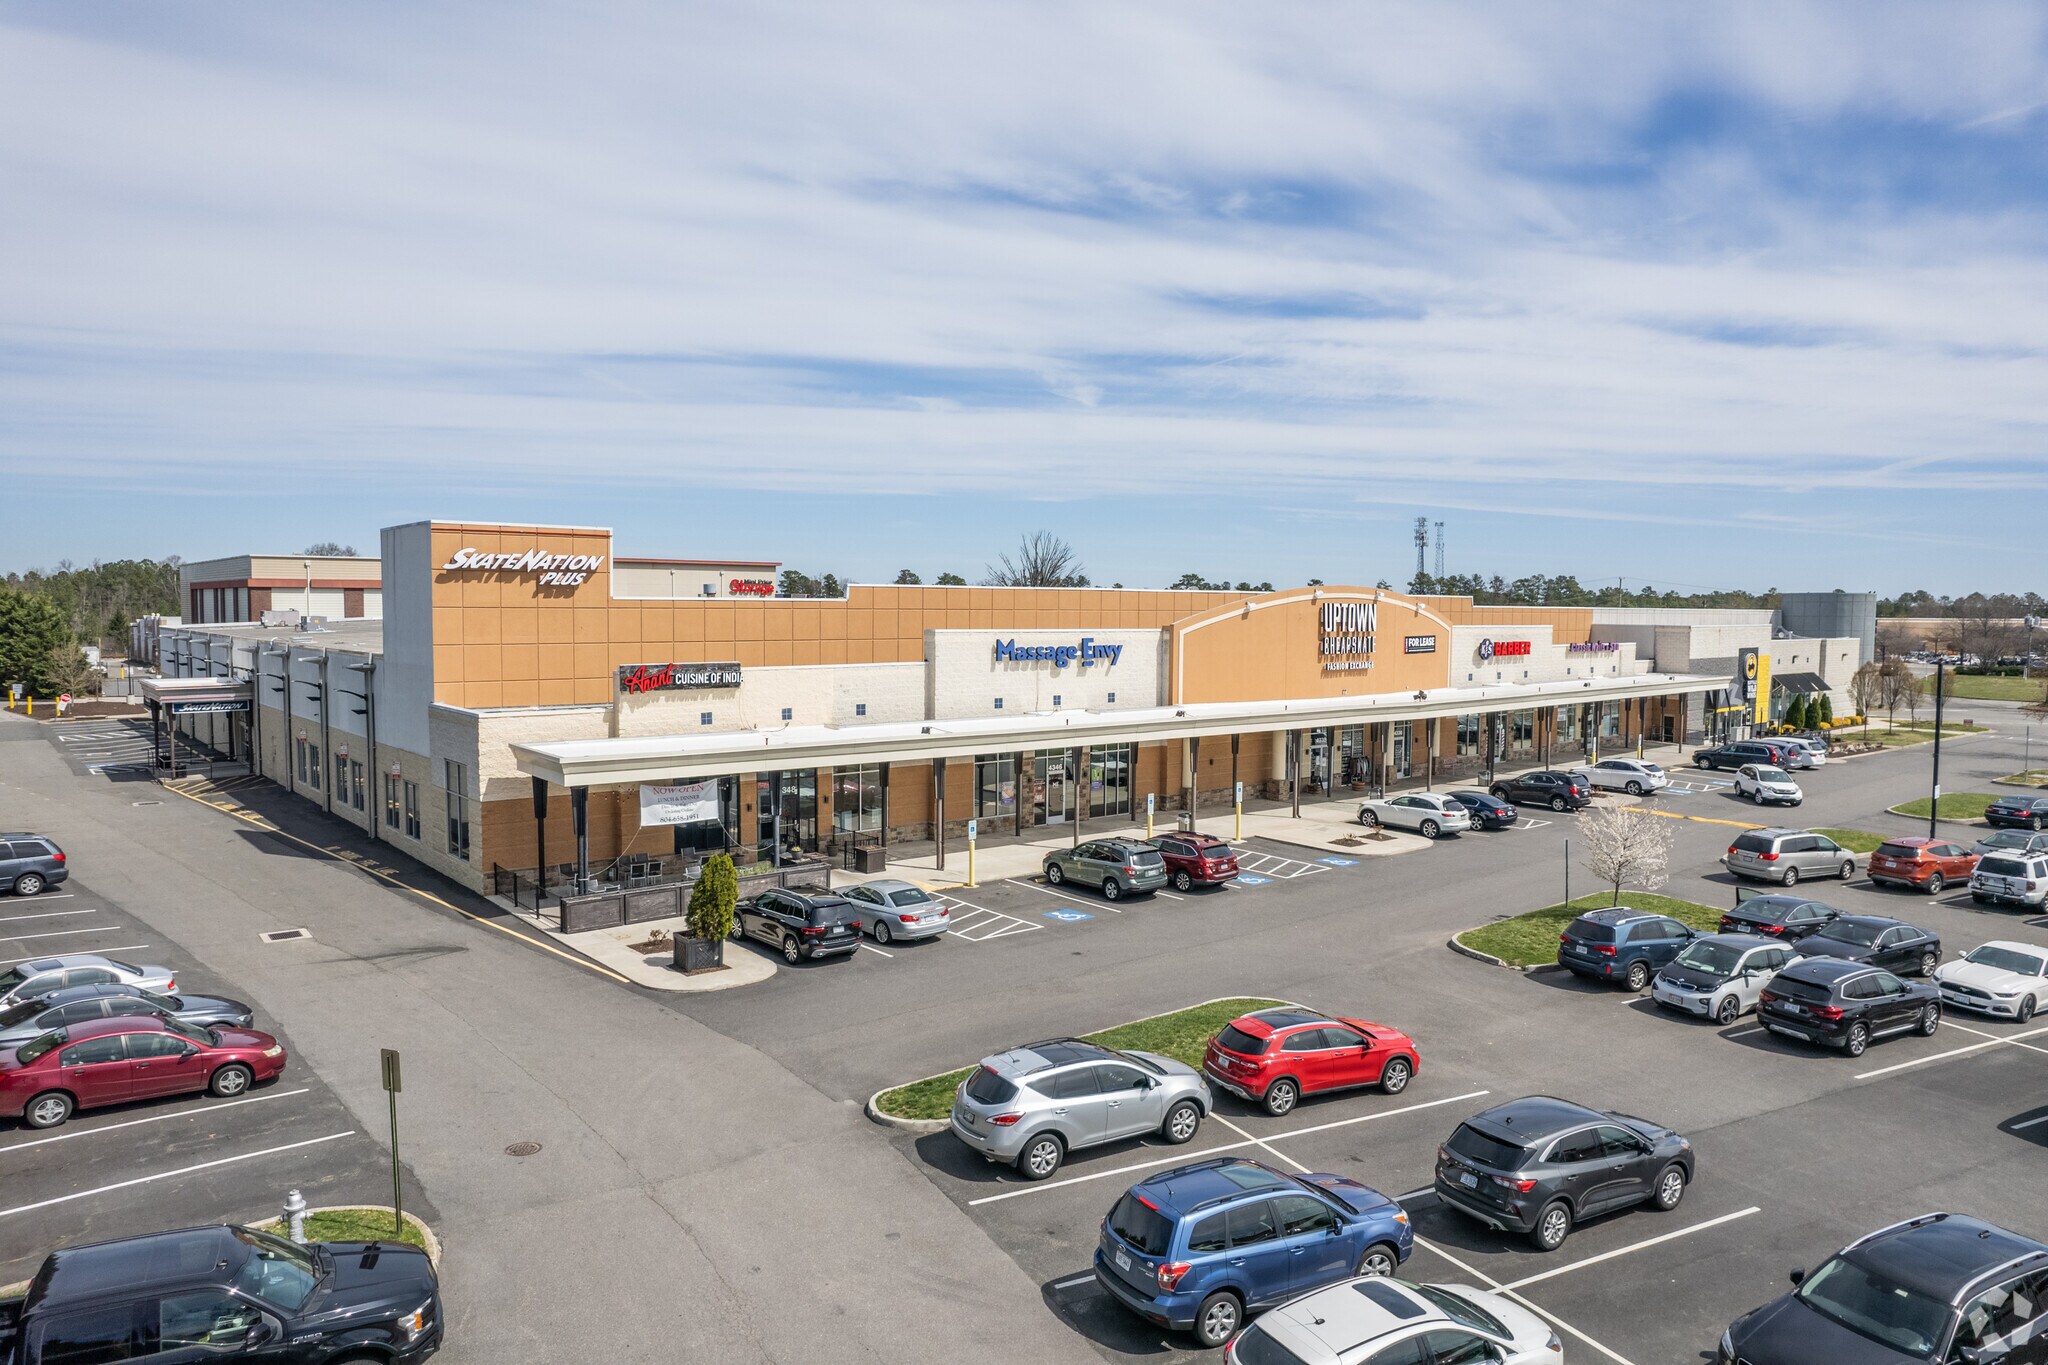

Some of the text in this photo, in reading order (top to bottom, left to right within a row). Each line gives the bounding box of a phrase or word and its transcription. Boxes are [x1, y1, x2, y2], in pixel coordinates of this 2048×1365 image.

[539, 572, 587, 585] PLUS
[730, 579, 774, 596] Storage
[1323, 603, 1376, 632] UPTOWN
[1324, 636, 1376, 655] CHEAPSKATE
[1408, 637, 1435, 646] FOR LEASE
[1494, 641, 1531, 656] BARBER
[996, 637, 1123, 668] Massage Envy
[1326, 661, 1374, 671] FASHION EXCHANGE
[675, 672, 709, 685] CUISINE
[710, 672, 721, 683] OF
[722, 671, 744, 683] INDIA
[653, 784, 704, 795] NOW OPEN
